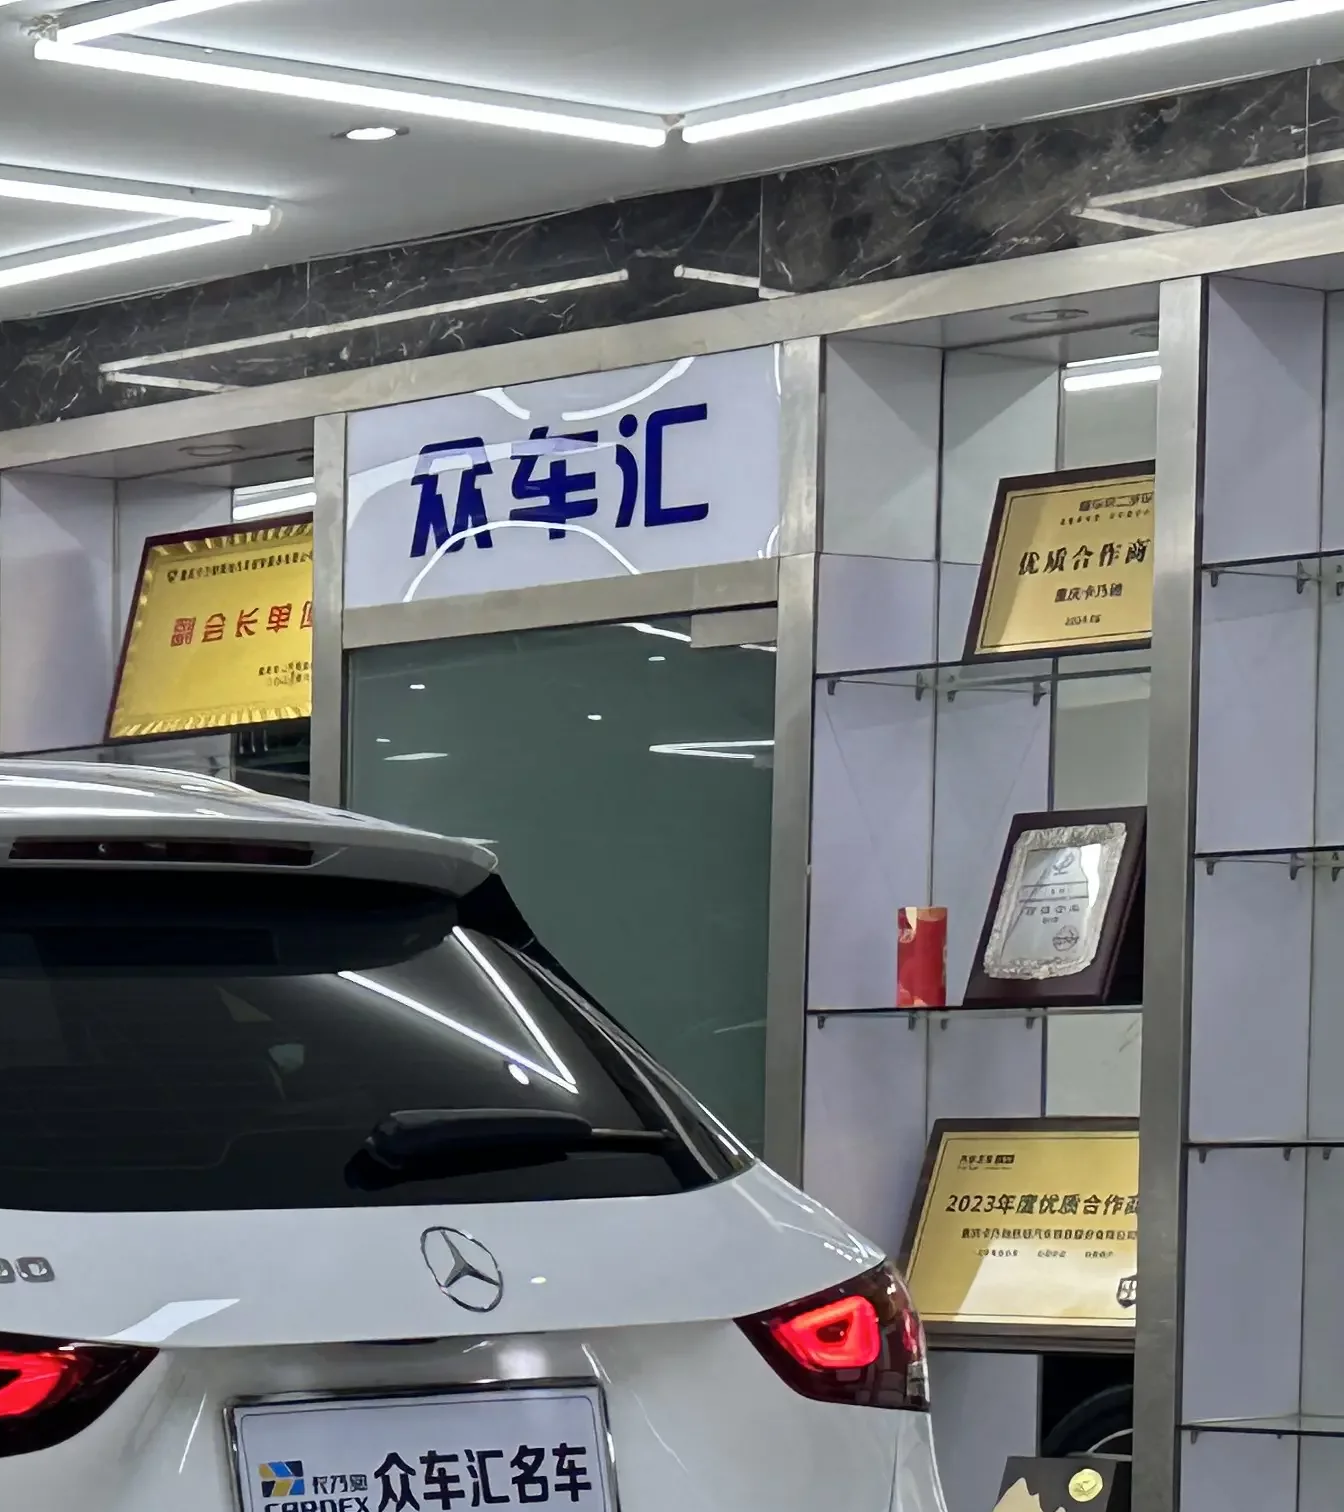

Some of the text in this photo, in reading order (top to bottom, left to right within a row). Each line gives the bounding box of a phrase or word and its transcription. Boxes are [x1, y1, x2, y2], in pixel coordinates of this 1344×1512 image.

[410, 402, 710, 558] 众车汇
[1018, 538, 1151, 576] 优质合作商
